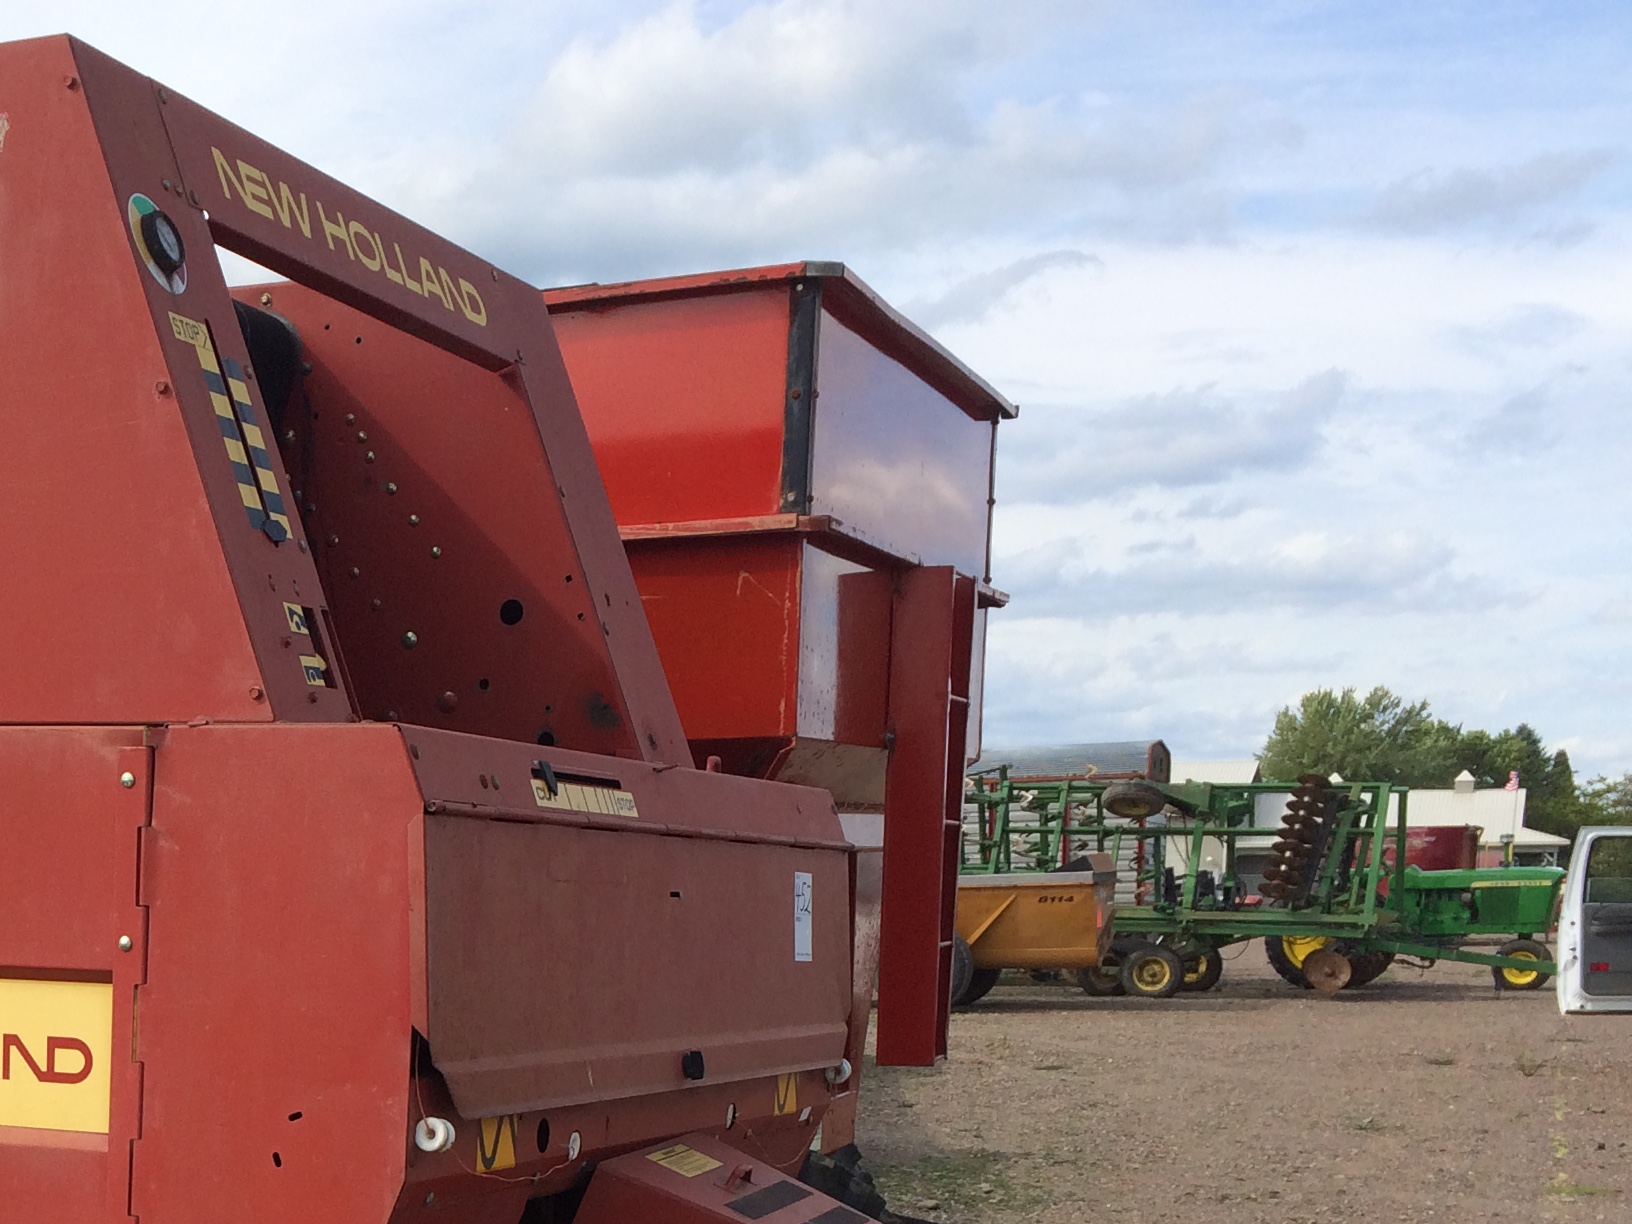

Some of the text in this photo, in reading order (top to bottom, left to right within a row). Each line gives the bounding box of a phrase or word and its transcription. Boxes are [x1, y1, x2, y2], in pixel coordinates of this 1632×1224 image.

[211, 145, 488, 328] NEW HOLLAND
[171, 315, 200, 341] STOP
